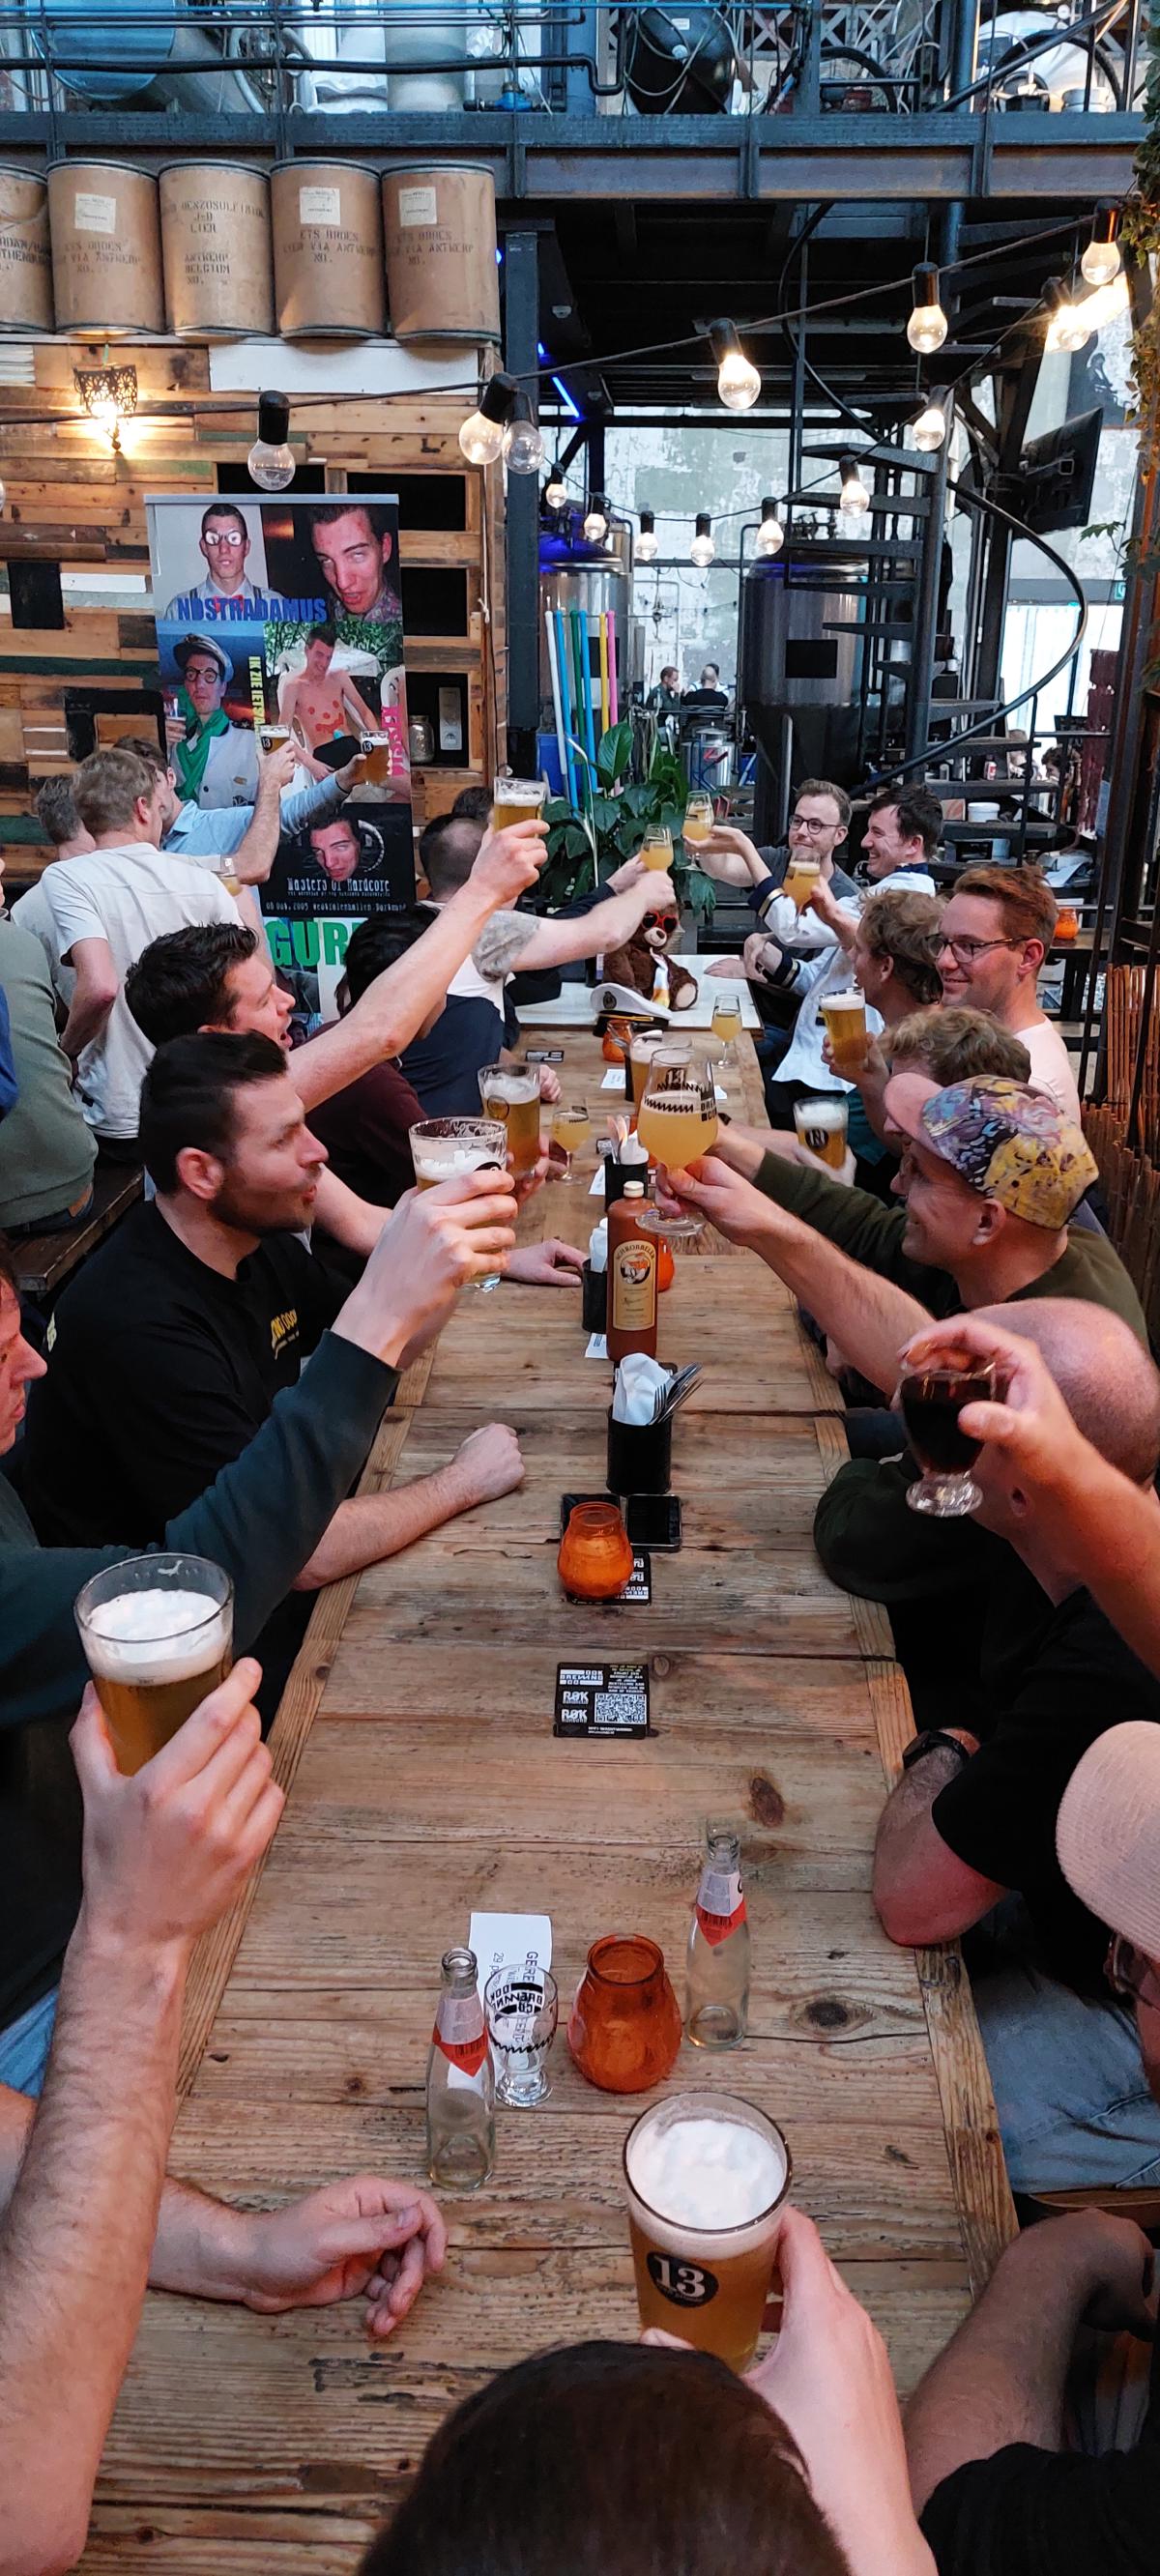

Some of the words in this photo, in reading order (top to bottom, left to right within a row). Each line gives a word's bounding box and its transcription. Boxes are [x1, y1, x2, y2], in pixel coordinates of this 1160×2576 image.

[177, 597, 328, 622] NOSTRADAMUS
[248, 655, 262, 670] IK
[249, 671, 264, 688] ZIE
[287, 878, 328, 891] Masters
[347, 878, 391, 892] Hardcore
[494, 1952, 504, 1963] 29
[653, 2255, 706, 2298] 13
